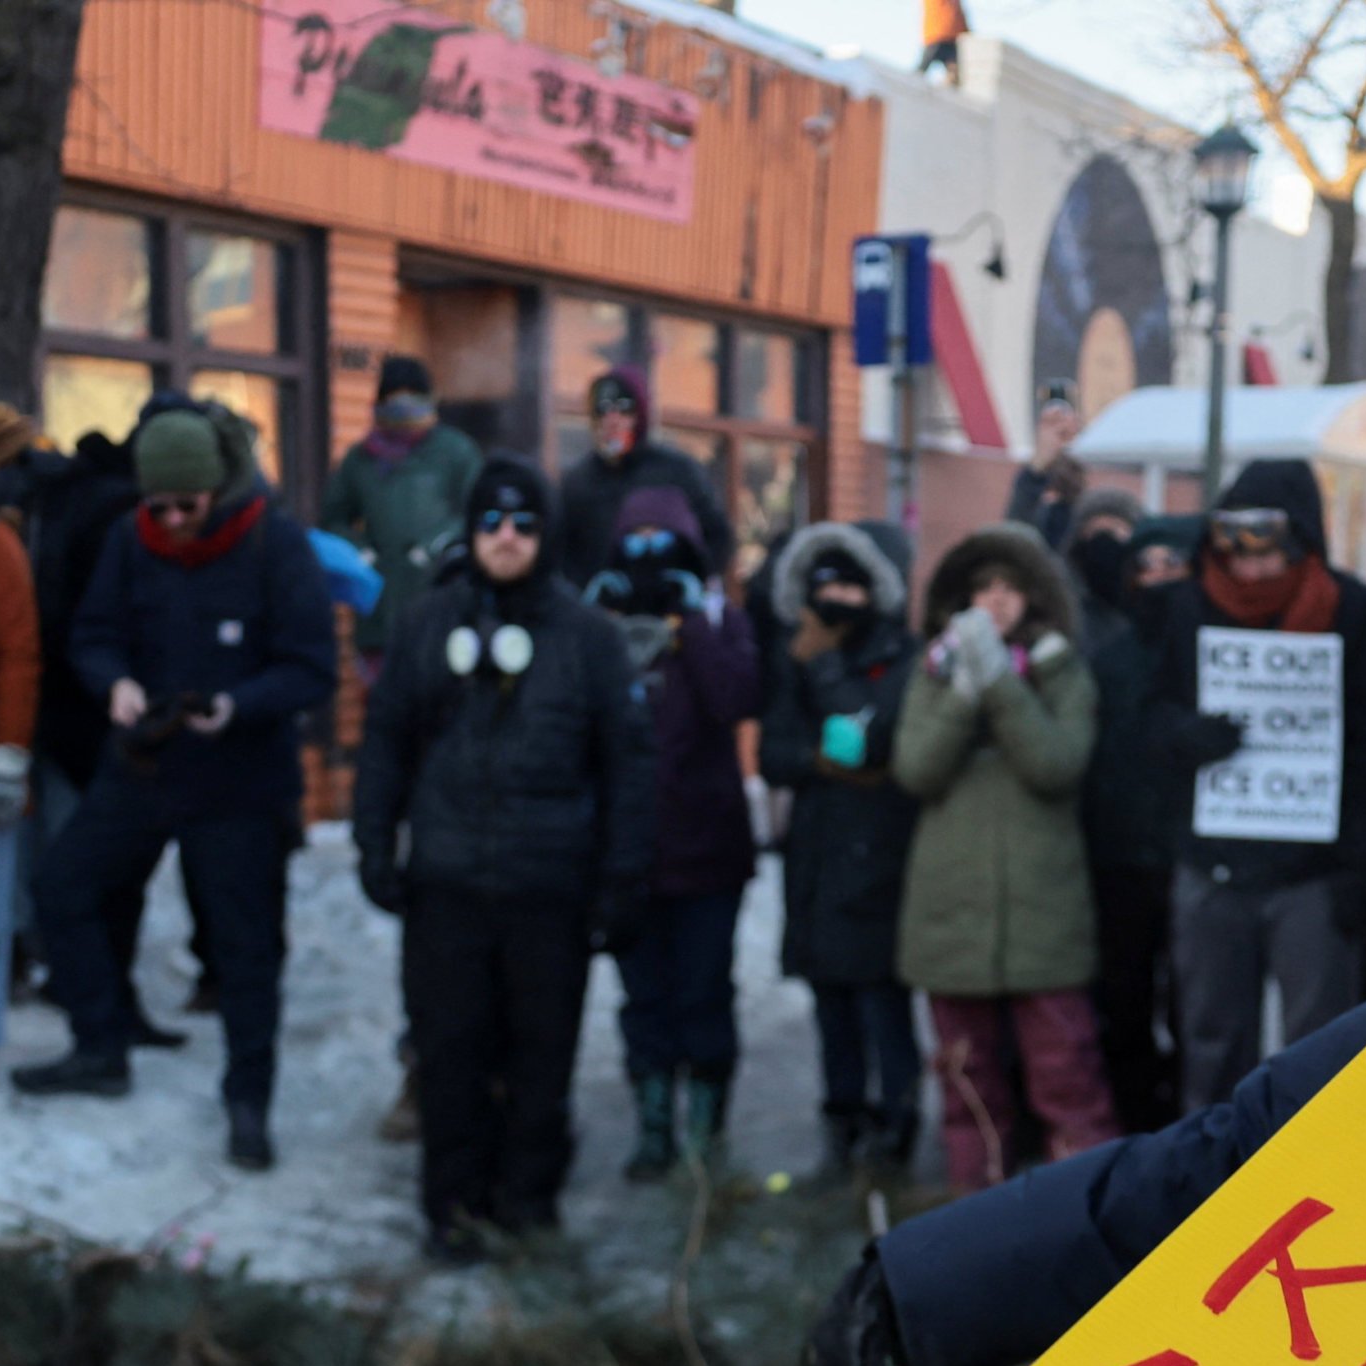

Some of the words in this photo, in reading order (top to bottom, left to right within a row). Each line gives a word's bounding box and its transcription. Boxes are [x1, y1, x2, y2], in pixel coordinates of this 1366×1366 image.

[1210, 642, 1251, 671] ICE
[1263, 646, 1332, 673] OUT
[1262, 706, 1332, 734] OUT
[1210, 766, 1251, 796] ICE
[1261, 769, 1331, 799] OUT
